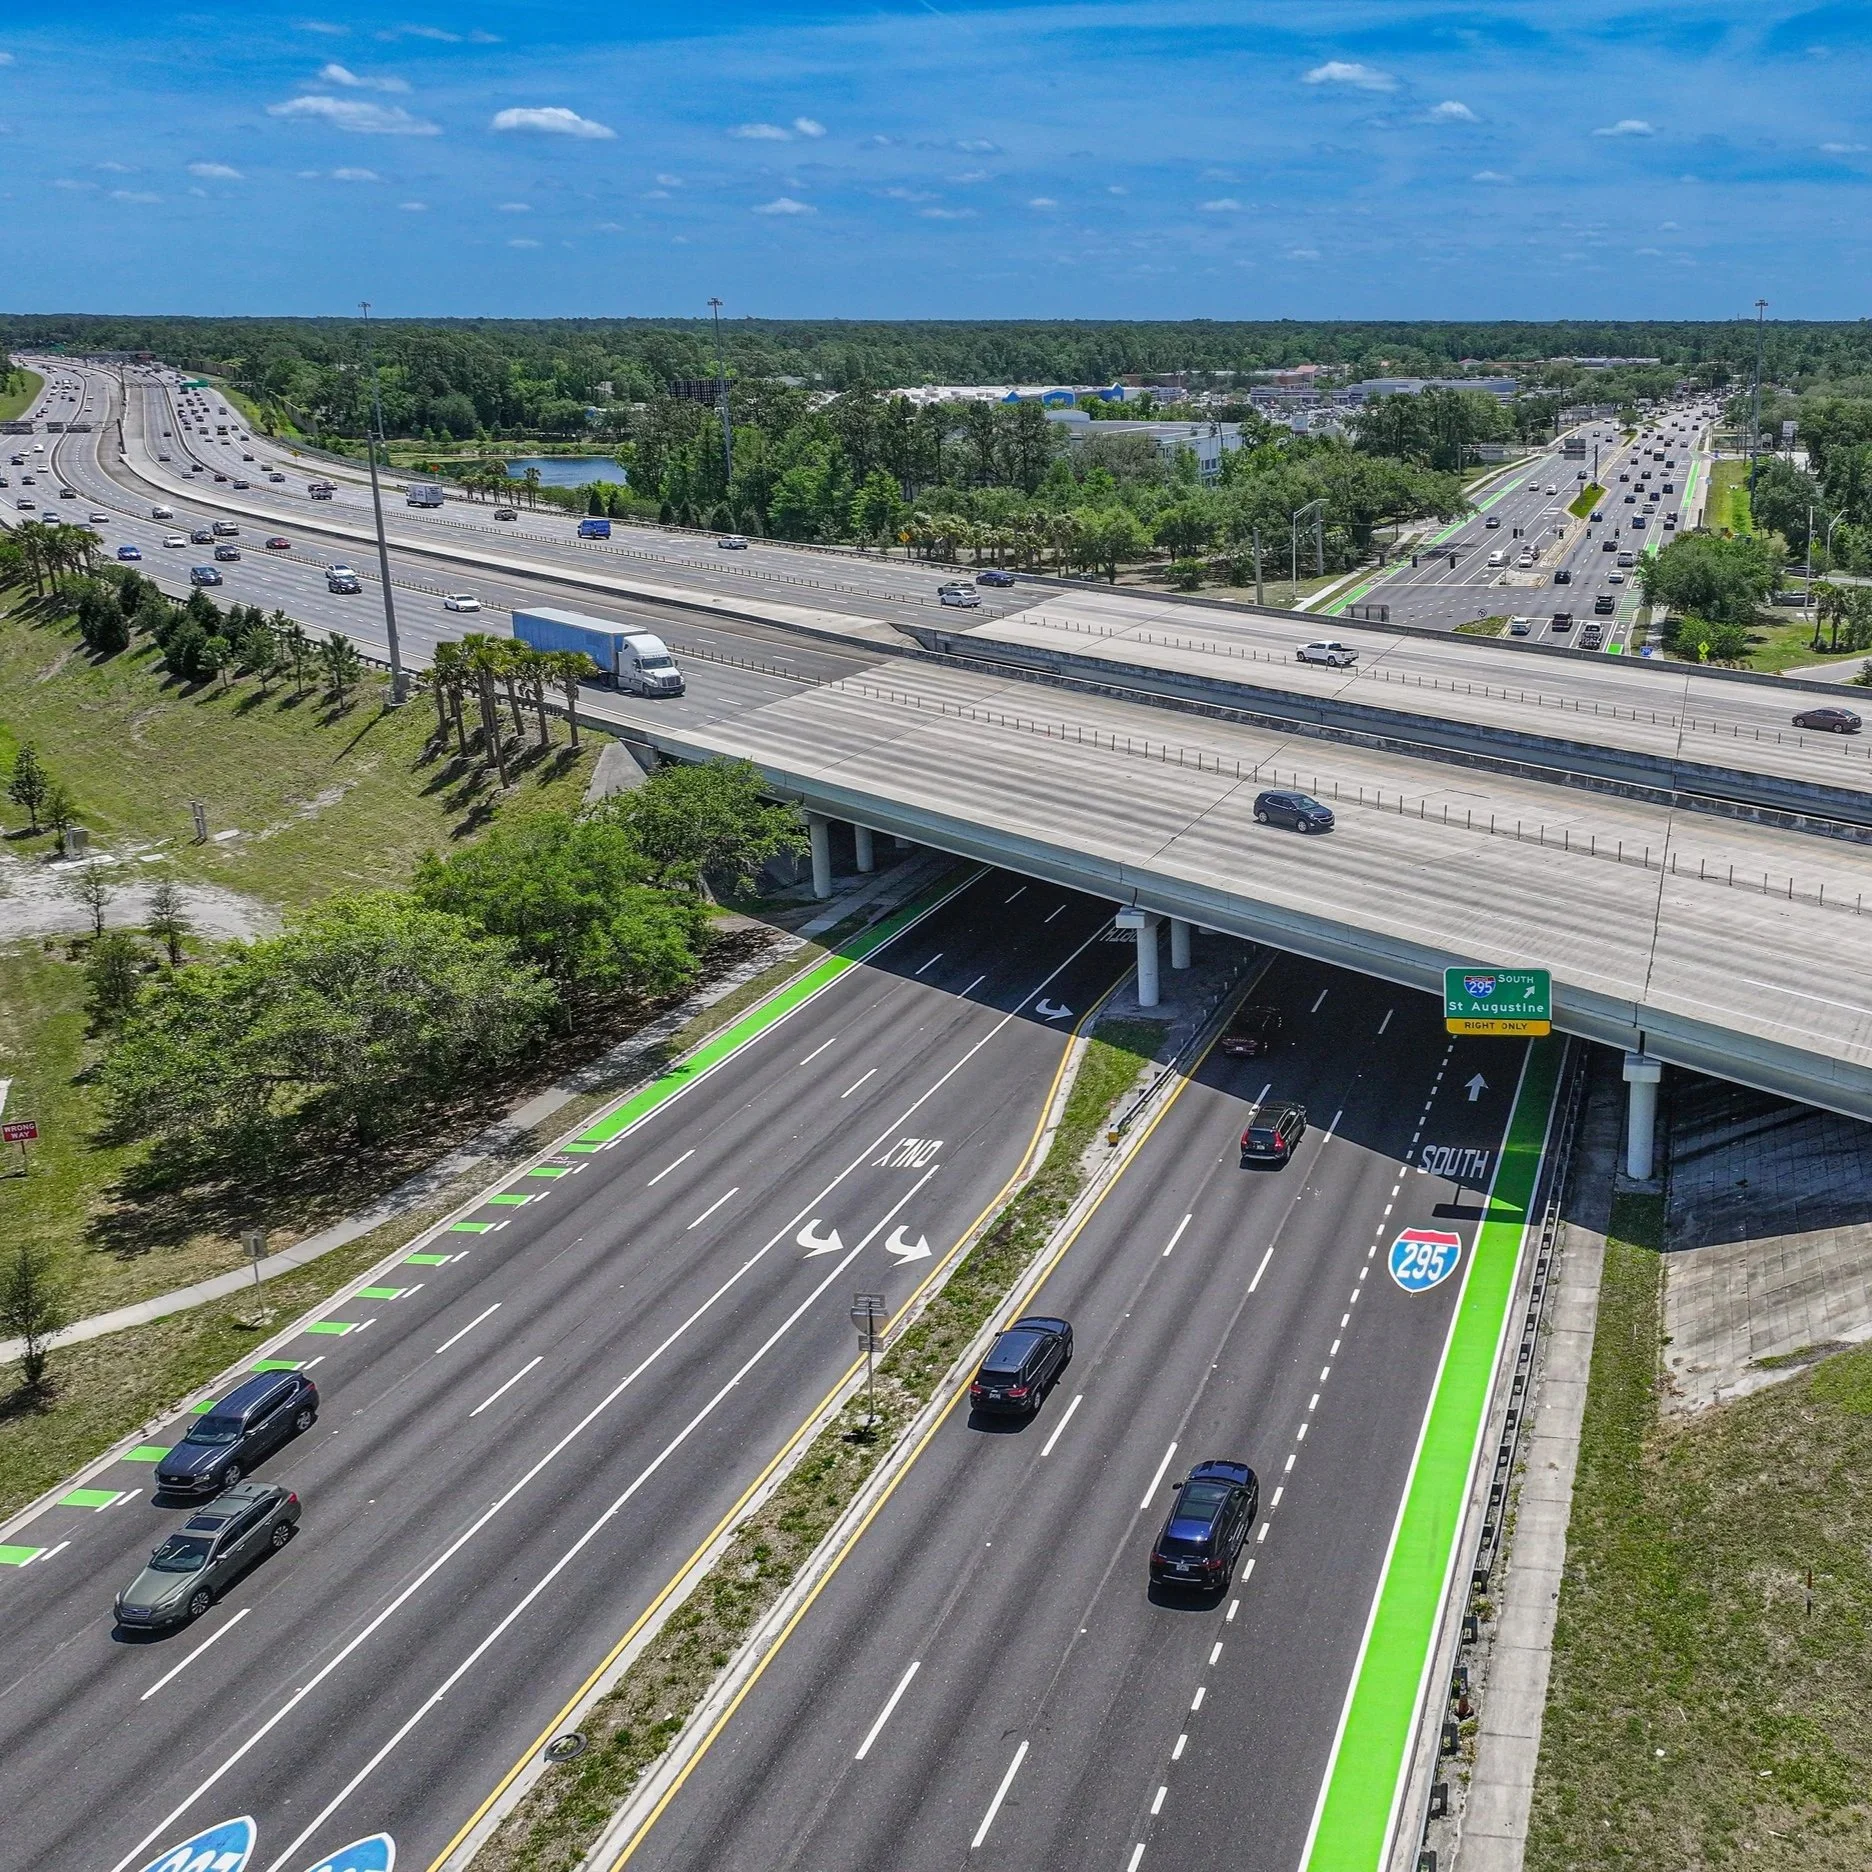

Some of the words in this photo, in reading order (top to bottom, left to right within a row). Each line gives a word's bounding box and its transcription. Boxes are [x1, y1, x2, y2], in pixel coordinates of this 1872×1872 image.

[1498, 974, 1534, 984] SOUTH
[1469, 981, 1492, 993] 295
[1449, 1001, 1463, 1010] St
[1472, 1002, 1544, 1013] Augustine
[1464, 1021, 1496, 1030] RIGHT
[1501, 1022, 1528, 1030] ONLY
[4, 1123, 34, 1132] WRONG
[11, 1131, 30, 1139] WAY
[871, 1138, 944, 1167] ONLY
[1417, 1144, 1490, 1179] SOUTH
[1396, 1243, 1449, 1281] 295
